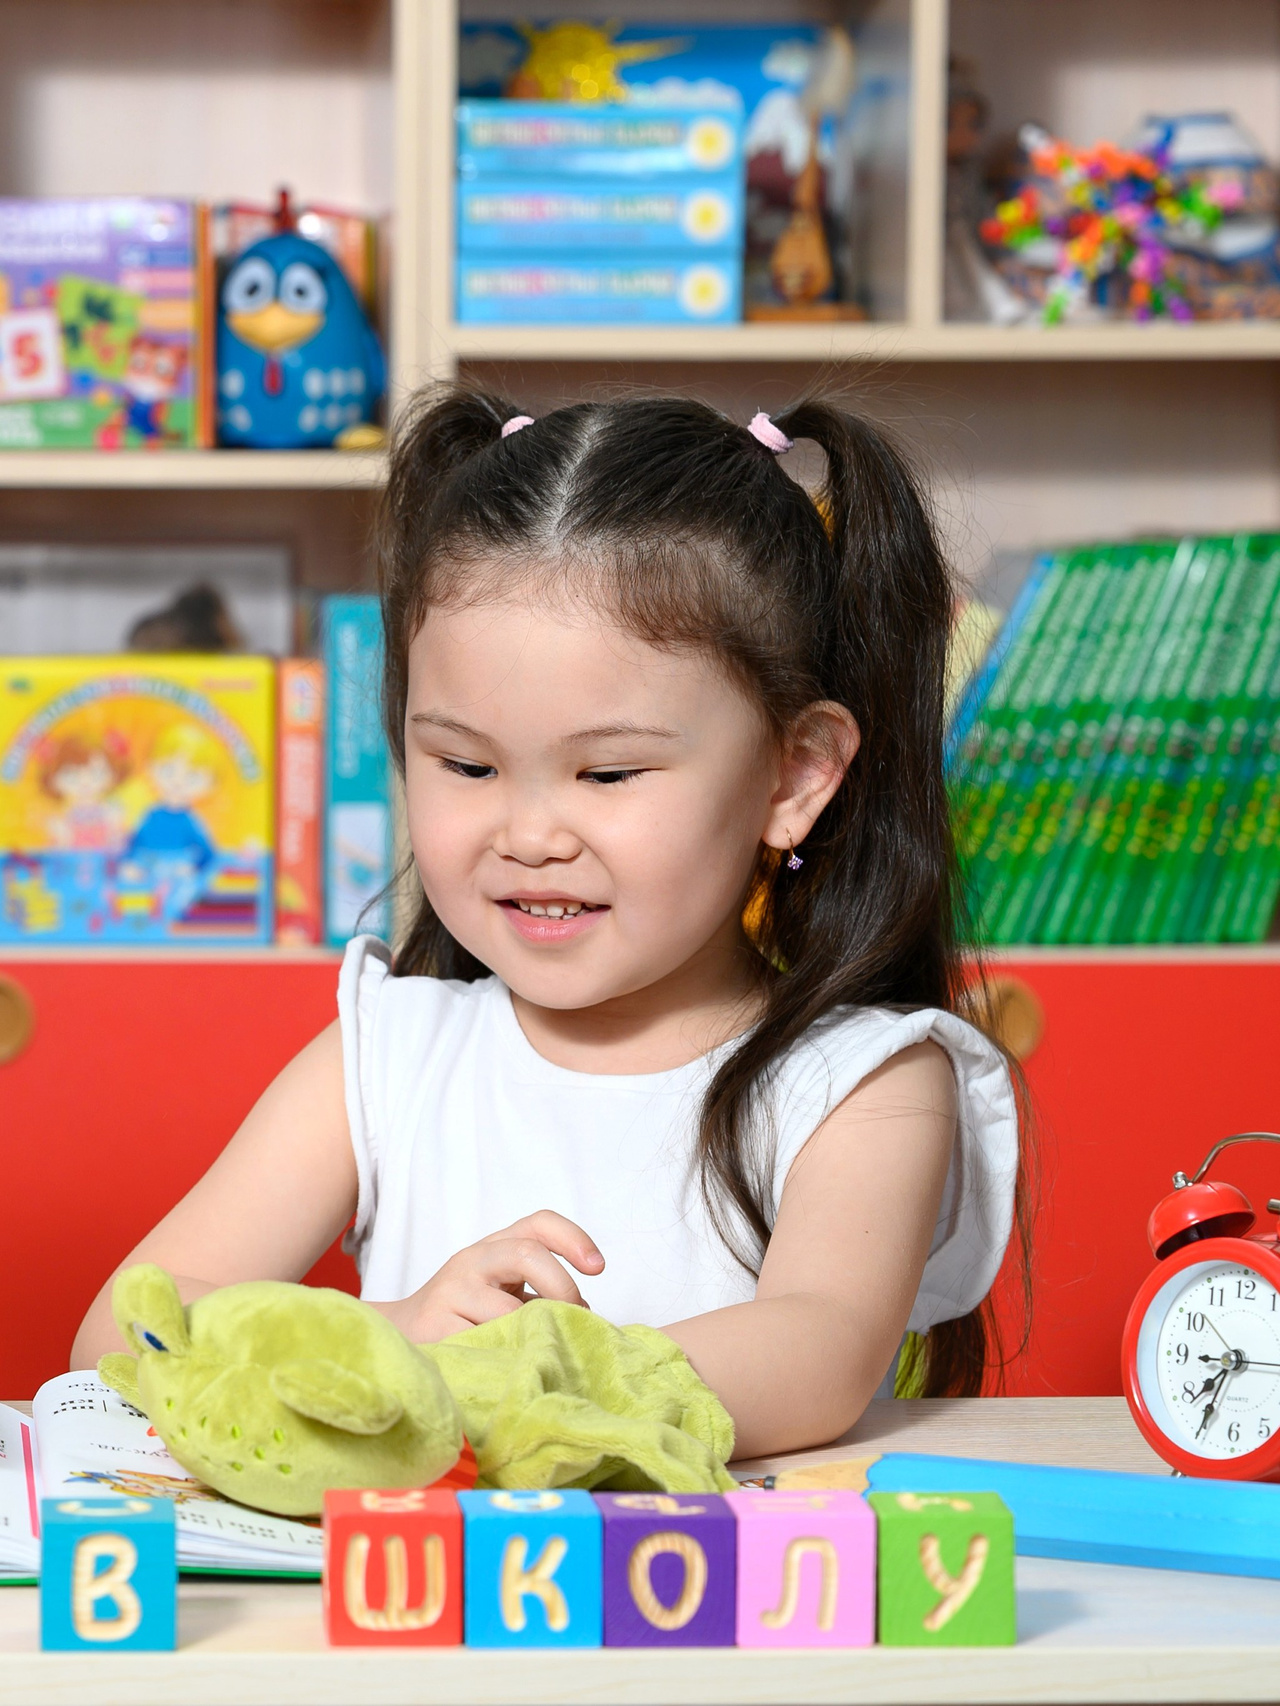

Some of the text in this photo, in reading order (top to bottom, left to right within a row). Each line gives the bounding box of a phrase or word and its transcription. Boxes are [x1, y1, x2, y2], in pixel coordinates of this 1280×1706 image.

[1209, 1286, 1225, 1307] 11
[1235, 1279, 1257, 1301] 12
[1185, 1311, 1205, 1333] 10
[1176, 1342, 1189, 1366] 9
[1181, 1381, 1196, 1404] 8
[1226, 1395, 1249, 1403] QUARTZ
[1227, 1421, 1241, 1443] 6
[1258, 1417, 1271, 1439] 5
[73, 1531, 143, 1642] В
[343, 1531, 990, 1633] ШКОЛУ
